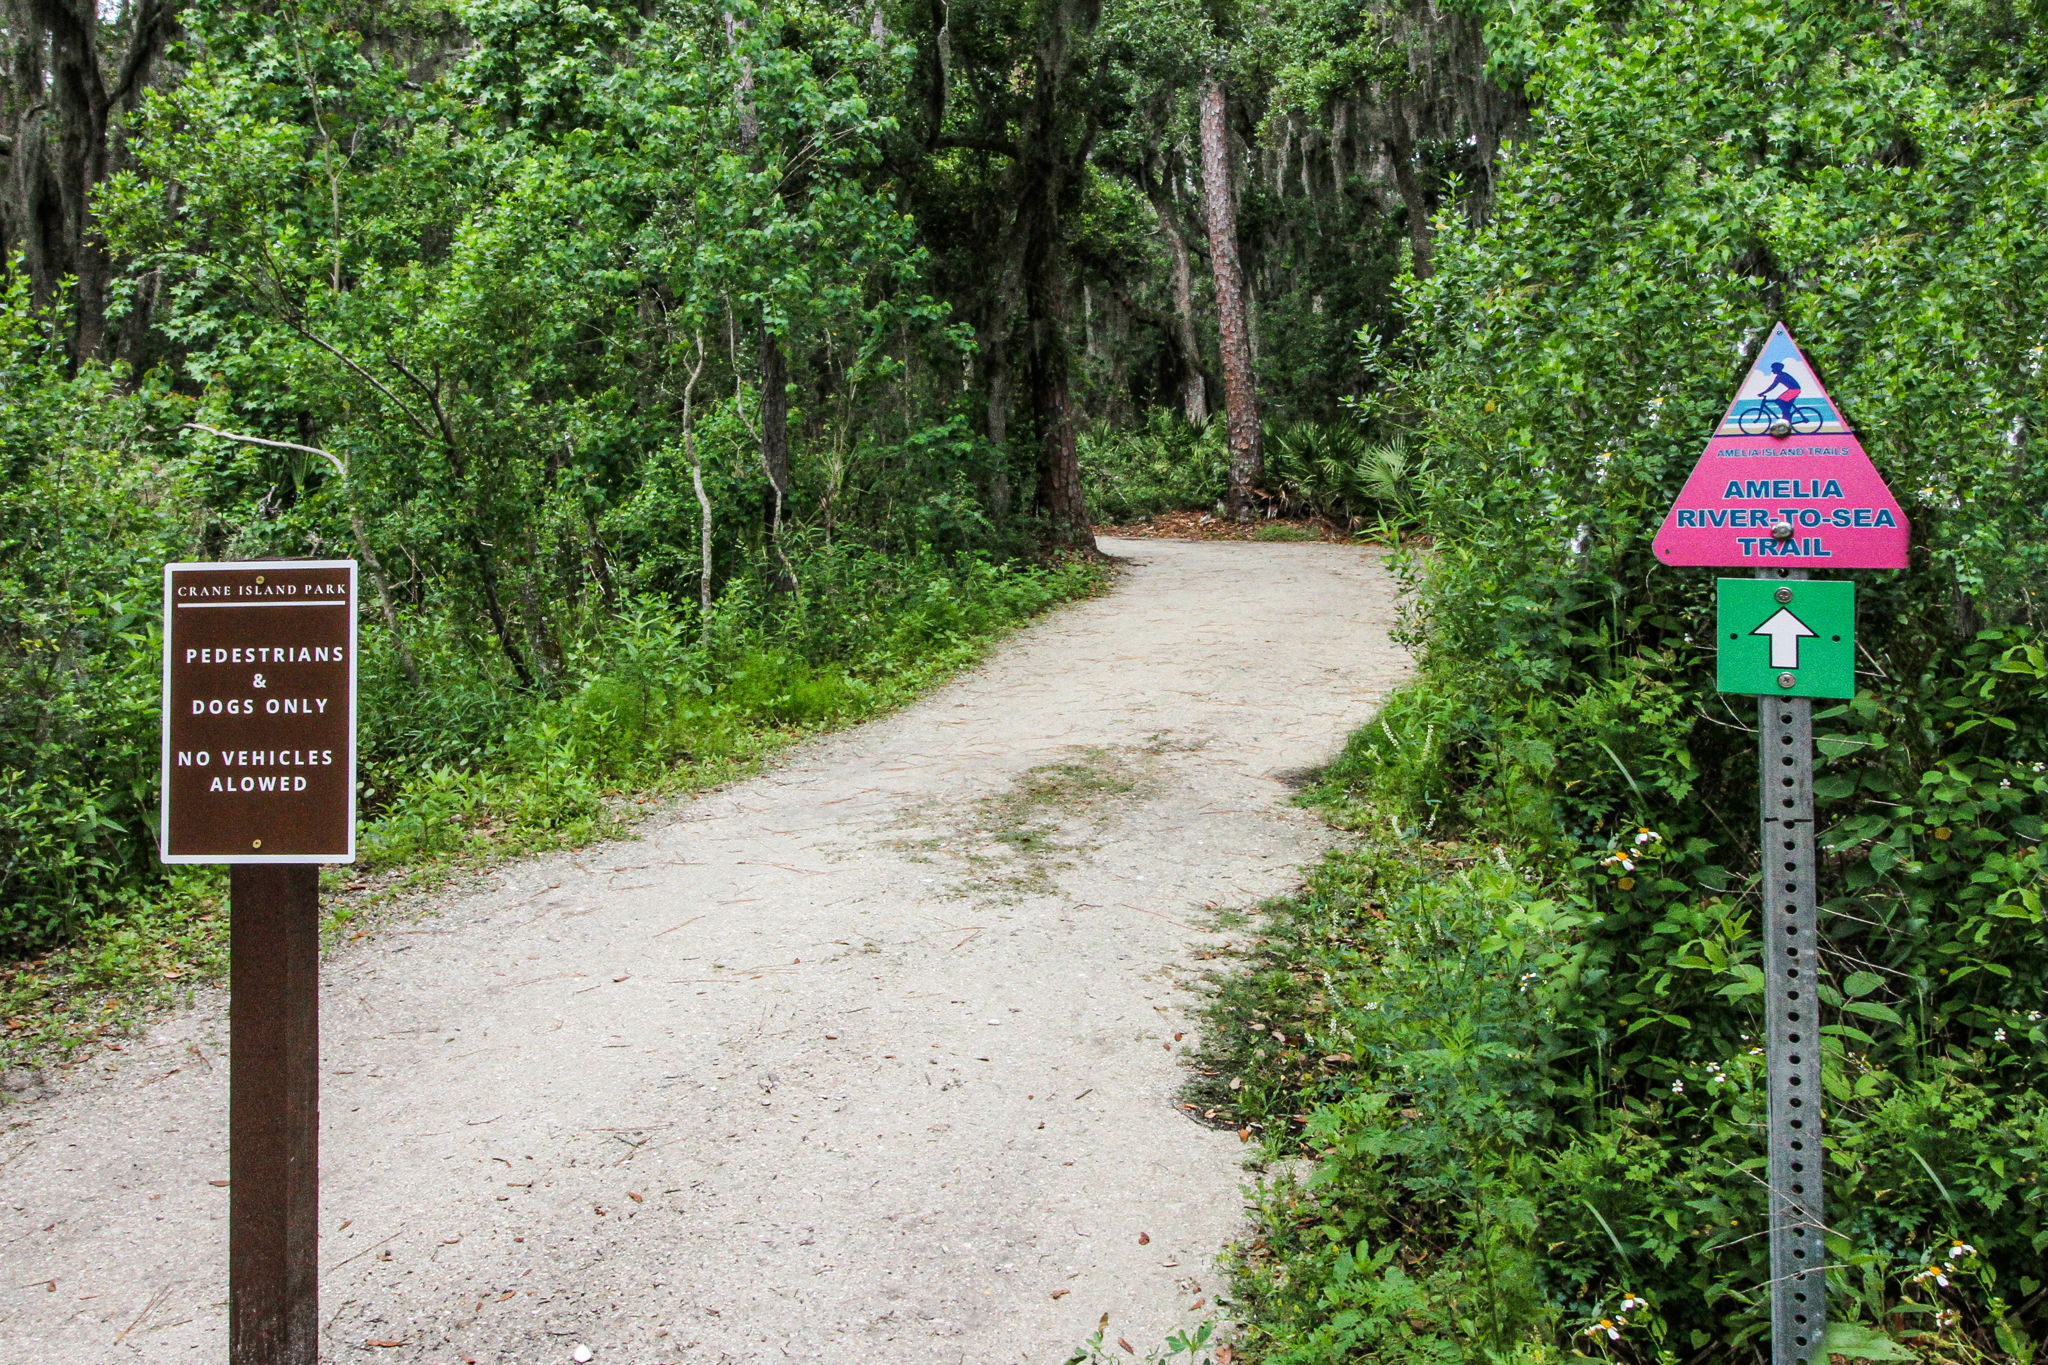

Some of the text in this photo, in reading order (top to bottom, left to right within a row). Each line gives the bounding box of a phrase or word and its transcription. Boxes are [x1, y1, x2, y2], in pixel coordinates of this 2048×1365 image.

[1717, 447, 1849, 457] AMELIA ISLAND TRAILS
[1723, 479, 1844, 499] AMELIA
[1676, 508, 1897, 528] RIVER-TO-SEA
[1736, 537, 1832, 557] TRAIL
[177, 583, 347, 597] CRANE ISLAND PARK
[186, 646, 344, 664] PEDESTRIANS
[252, 673, 267, 689] &
[192, 698, 328, 715] DOGS ONLY
[177, 750, 333, 766] NO VEHICLES
[209, 776, 307, 792] ALOWED
